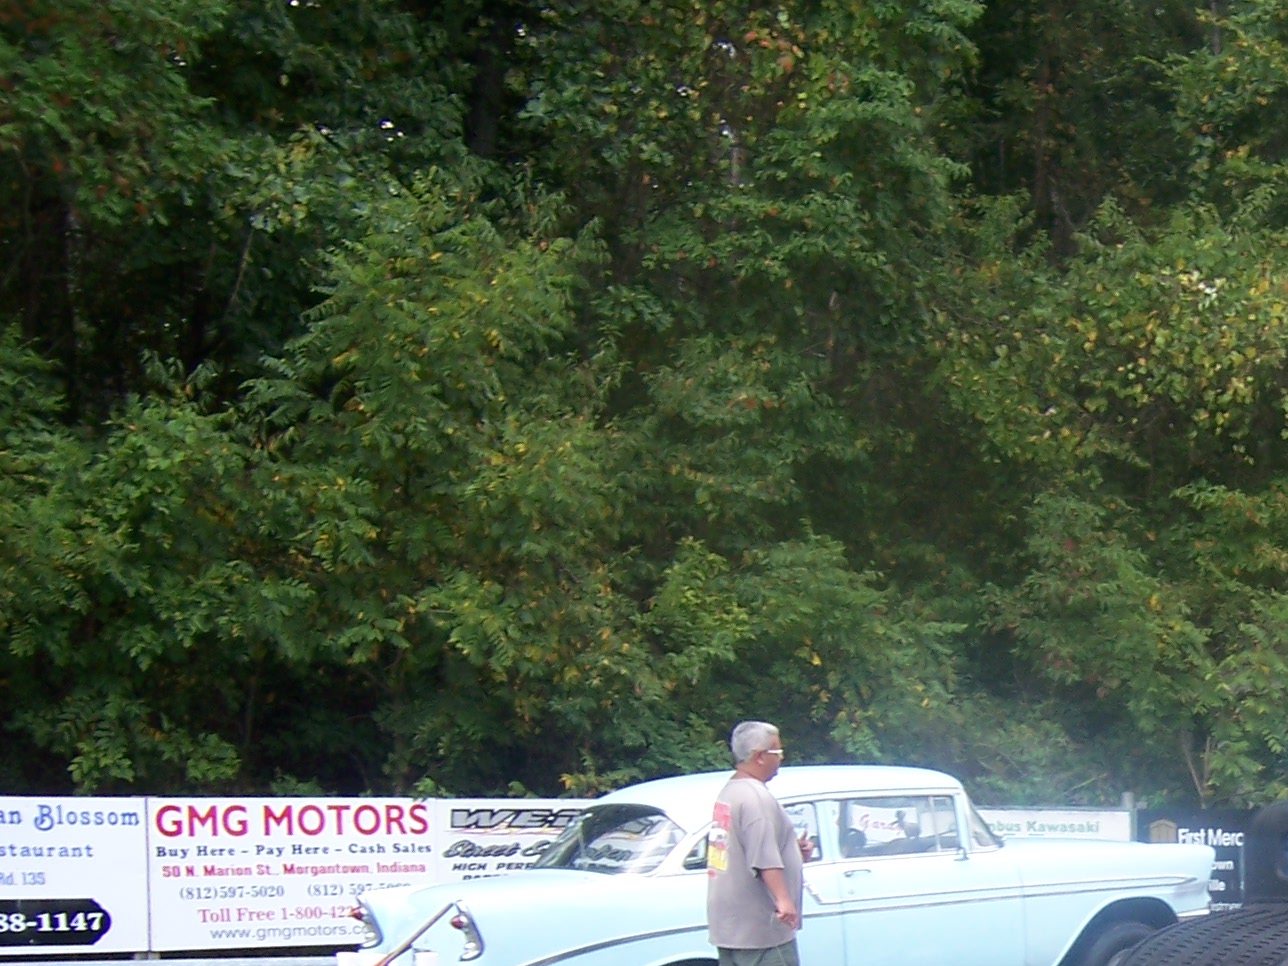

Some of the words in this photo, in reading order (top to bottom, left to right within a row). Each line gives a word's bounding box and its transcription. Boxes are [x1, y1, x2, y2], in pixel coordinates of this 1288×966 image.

[34, 804, 140, 831] Blossom
[155, 804, 249, 837] GMG
[263, 803, 429, 836] MOTORS
[1026, 820, 1100, 833] Kawasaki
[1178, 827, 1206, 846] First
[156, 846, 190, 859] Buy
[196, 845, 236, 857] Here
[256, 844, 285, 858] Pay
[291, 843, 329, 855] Here
[348, 843, 386, 854] Cash
[392, 842, 432, 853] Sales
[162, 865, 181, 878] 50
[203, 864, 252, 877] Marion
[376, 861, 426, 873] Indiana
[452, 862, 488, 871] HIGH
[21, 871, 46, 886] 135
[178, 885, 285, 900] (812)597-5020
[307, 883, 344, 898] (812)
[198, 907, 231, 923] Toll
[236, 906, 276, 921] Free
